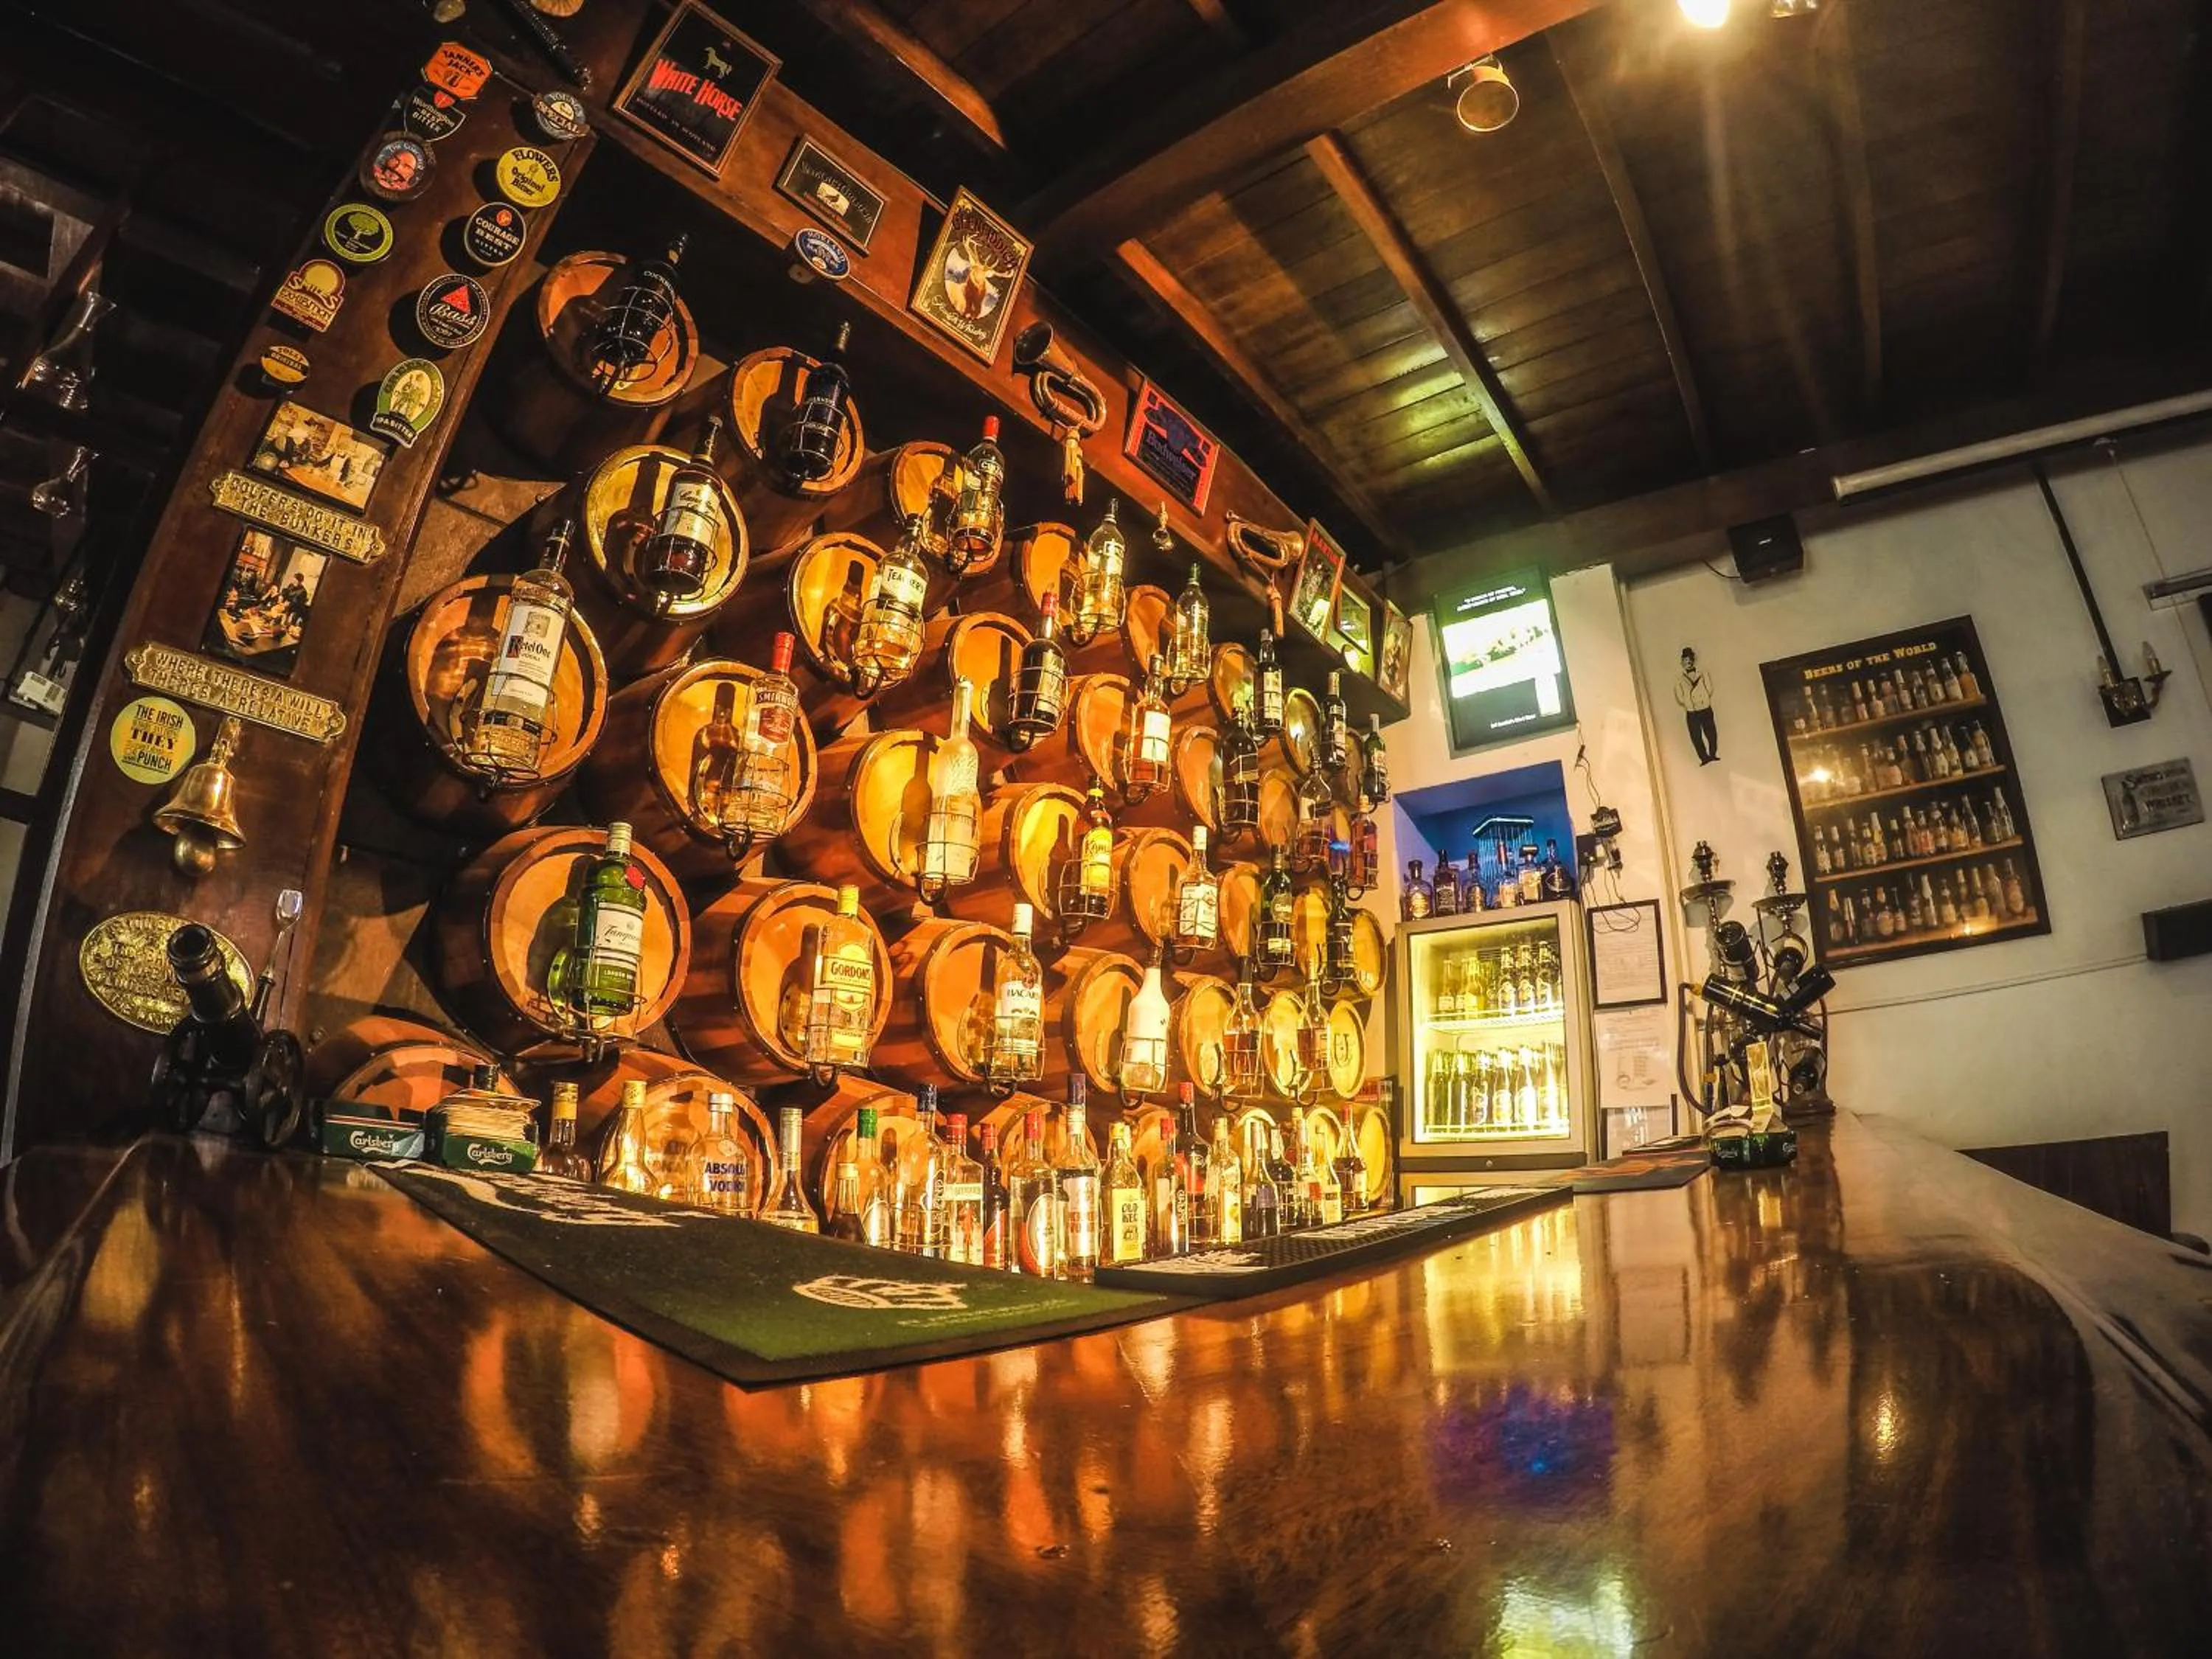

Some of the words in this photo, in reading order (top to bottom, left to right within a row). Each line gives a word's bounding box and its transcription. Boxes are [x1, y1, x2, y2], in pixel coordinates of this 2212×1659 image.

[648, 58, 698, 95] WHITE
[693, 79, 742, 121] HORSE
[536, 100, 581, 134] SPECIAL
[511, 149, 559, 183] FLOWERS
[475, 217, 521, 246] COURAGE
[428, 303, 477, 325] Bass
[240, 495, 269, 518] THE
[282, 512, 355, 550] BUNKERS
[305, 504, 323, 524] DO
[333, 514, 346, 532] IT
[351, 521, 369, 540] IN
[1804, 664, 1843, 680] BEERS
[1846, 659, 1863, 670] OF
[1865, 653, 1891, 666] THE
[1893, 642, 1937, 659] WORLD
[156, 651, 206, 680] WHERE
[290, 695, 325, 720] WILL
[134, 704, 156, 720] THE
[156, 710, 184, 729] IRISH
[237, 696, 311, 731] RELATIVE
[131, 726, 178, 750] THEY
[137, 749, 173, 771] PUNCH
[349, 1130, 397, 1152] Carlsber
[467, 1143, 513, 1165] Carlsberg
